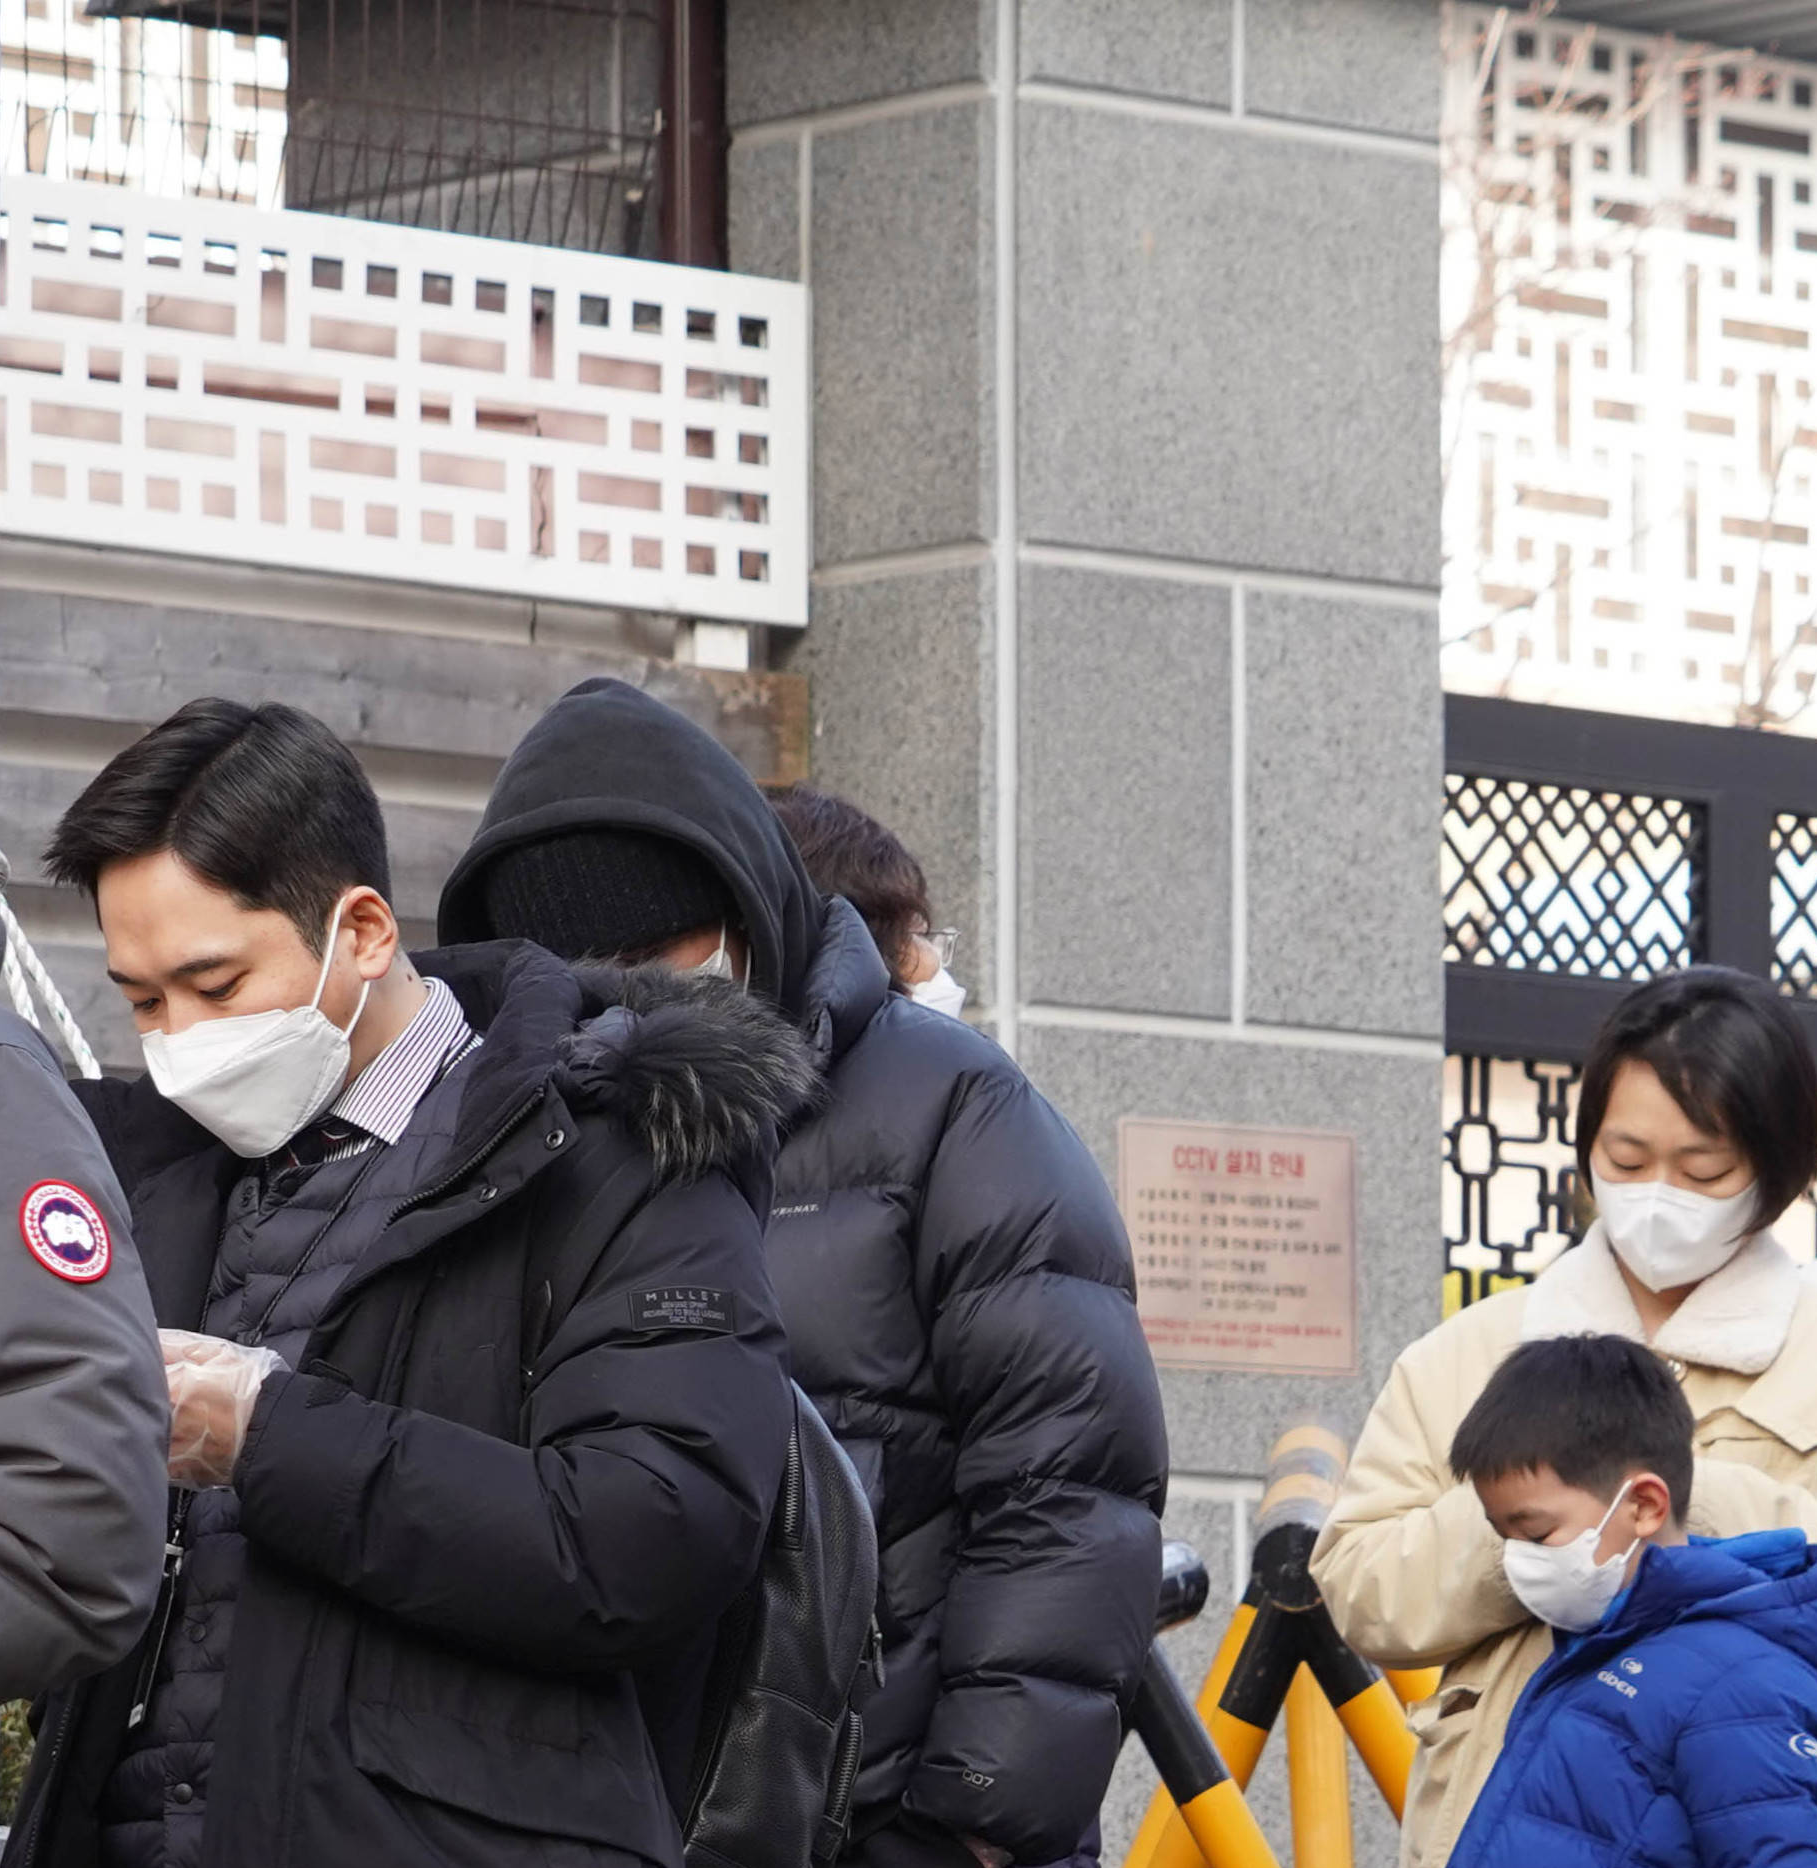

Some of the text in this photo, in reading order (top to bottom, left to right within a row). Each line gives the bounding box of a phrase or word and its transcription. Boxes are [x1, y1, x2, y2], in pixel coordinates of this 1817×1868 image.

[1172, 1144, 1305, 1177] CCTV 설치 안내
[644, 1290, 721, 1302] MILLET
